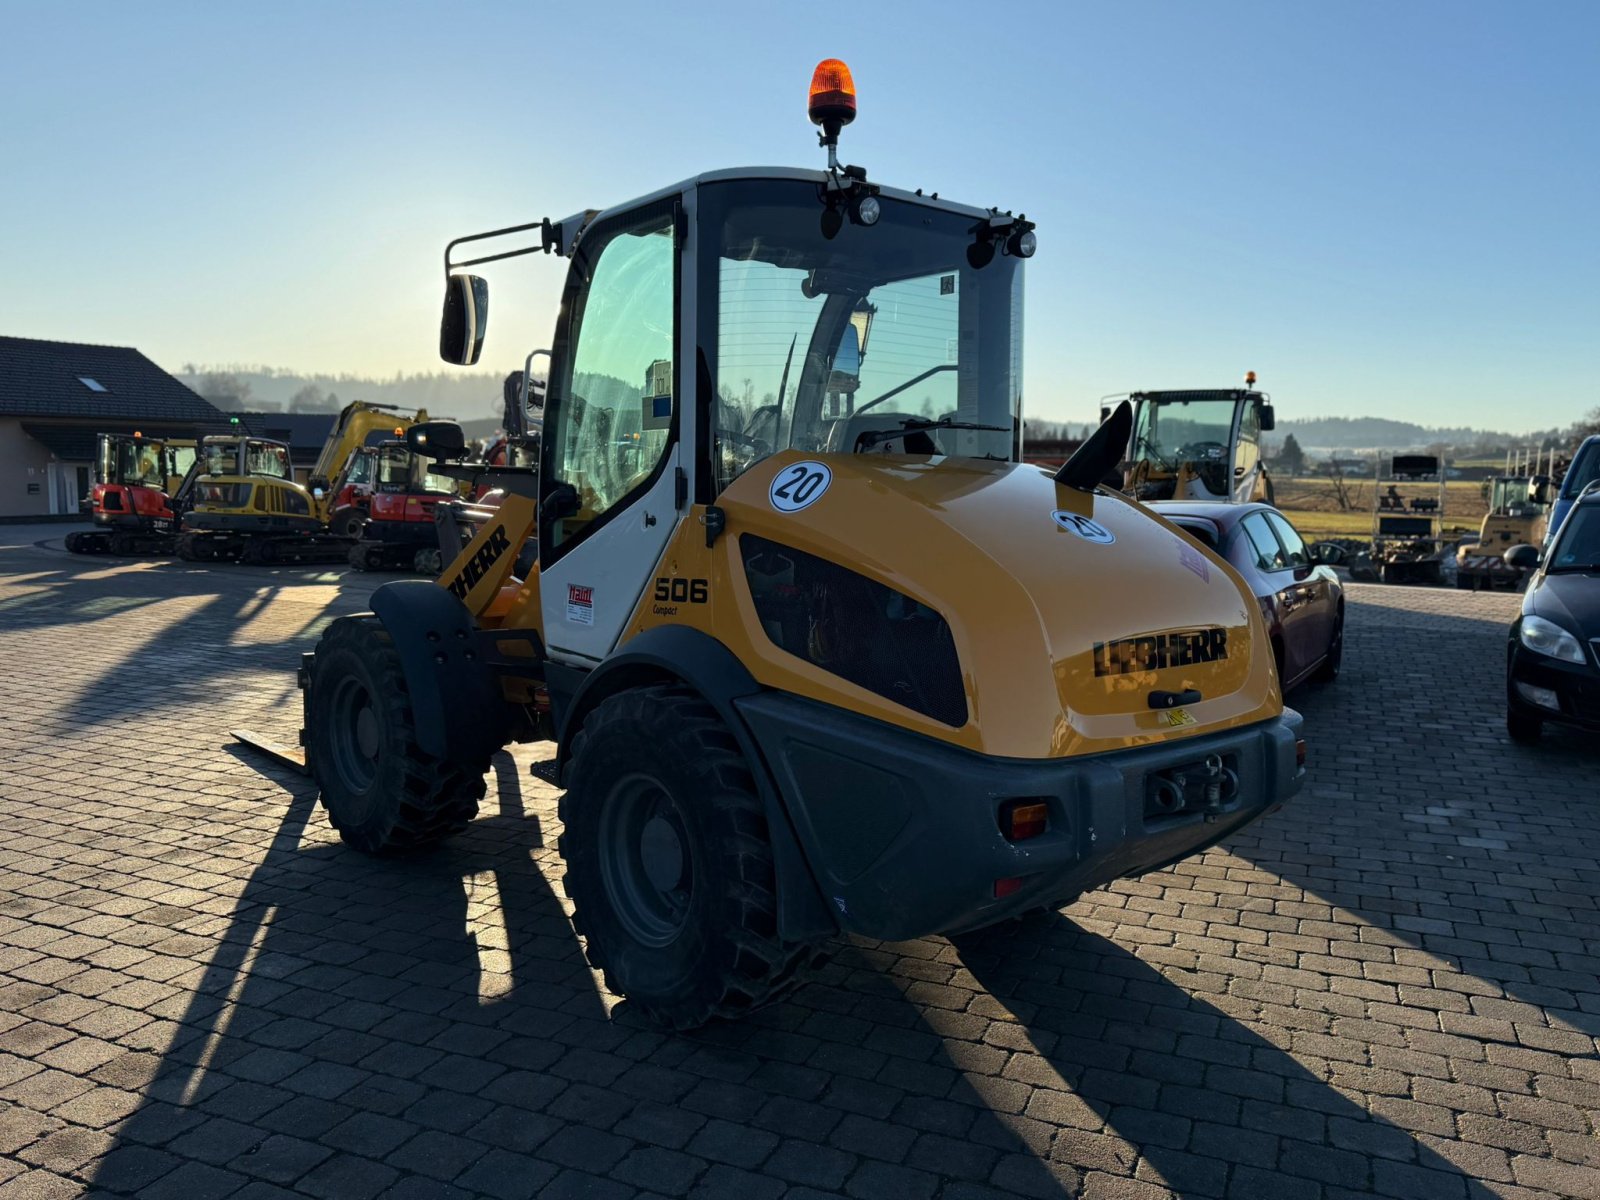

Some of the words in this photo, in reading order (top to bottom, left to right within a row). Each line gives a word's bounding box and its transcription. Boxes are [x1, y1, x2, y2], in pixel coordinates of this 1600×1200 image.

[774, 466, 824, 504] 20
[1059, 515, 1107, 537] 20
[654, 577, 709, 603] 506
[652, 603, 678, 617] Compact
[1092, 627, 1229, 678] LIEBHERR
